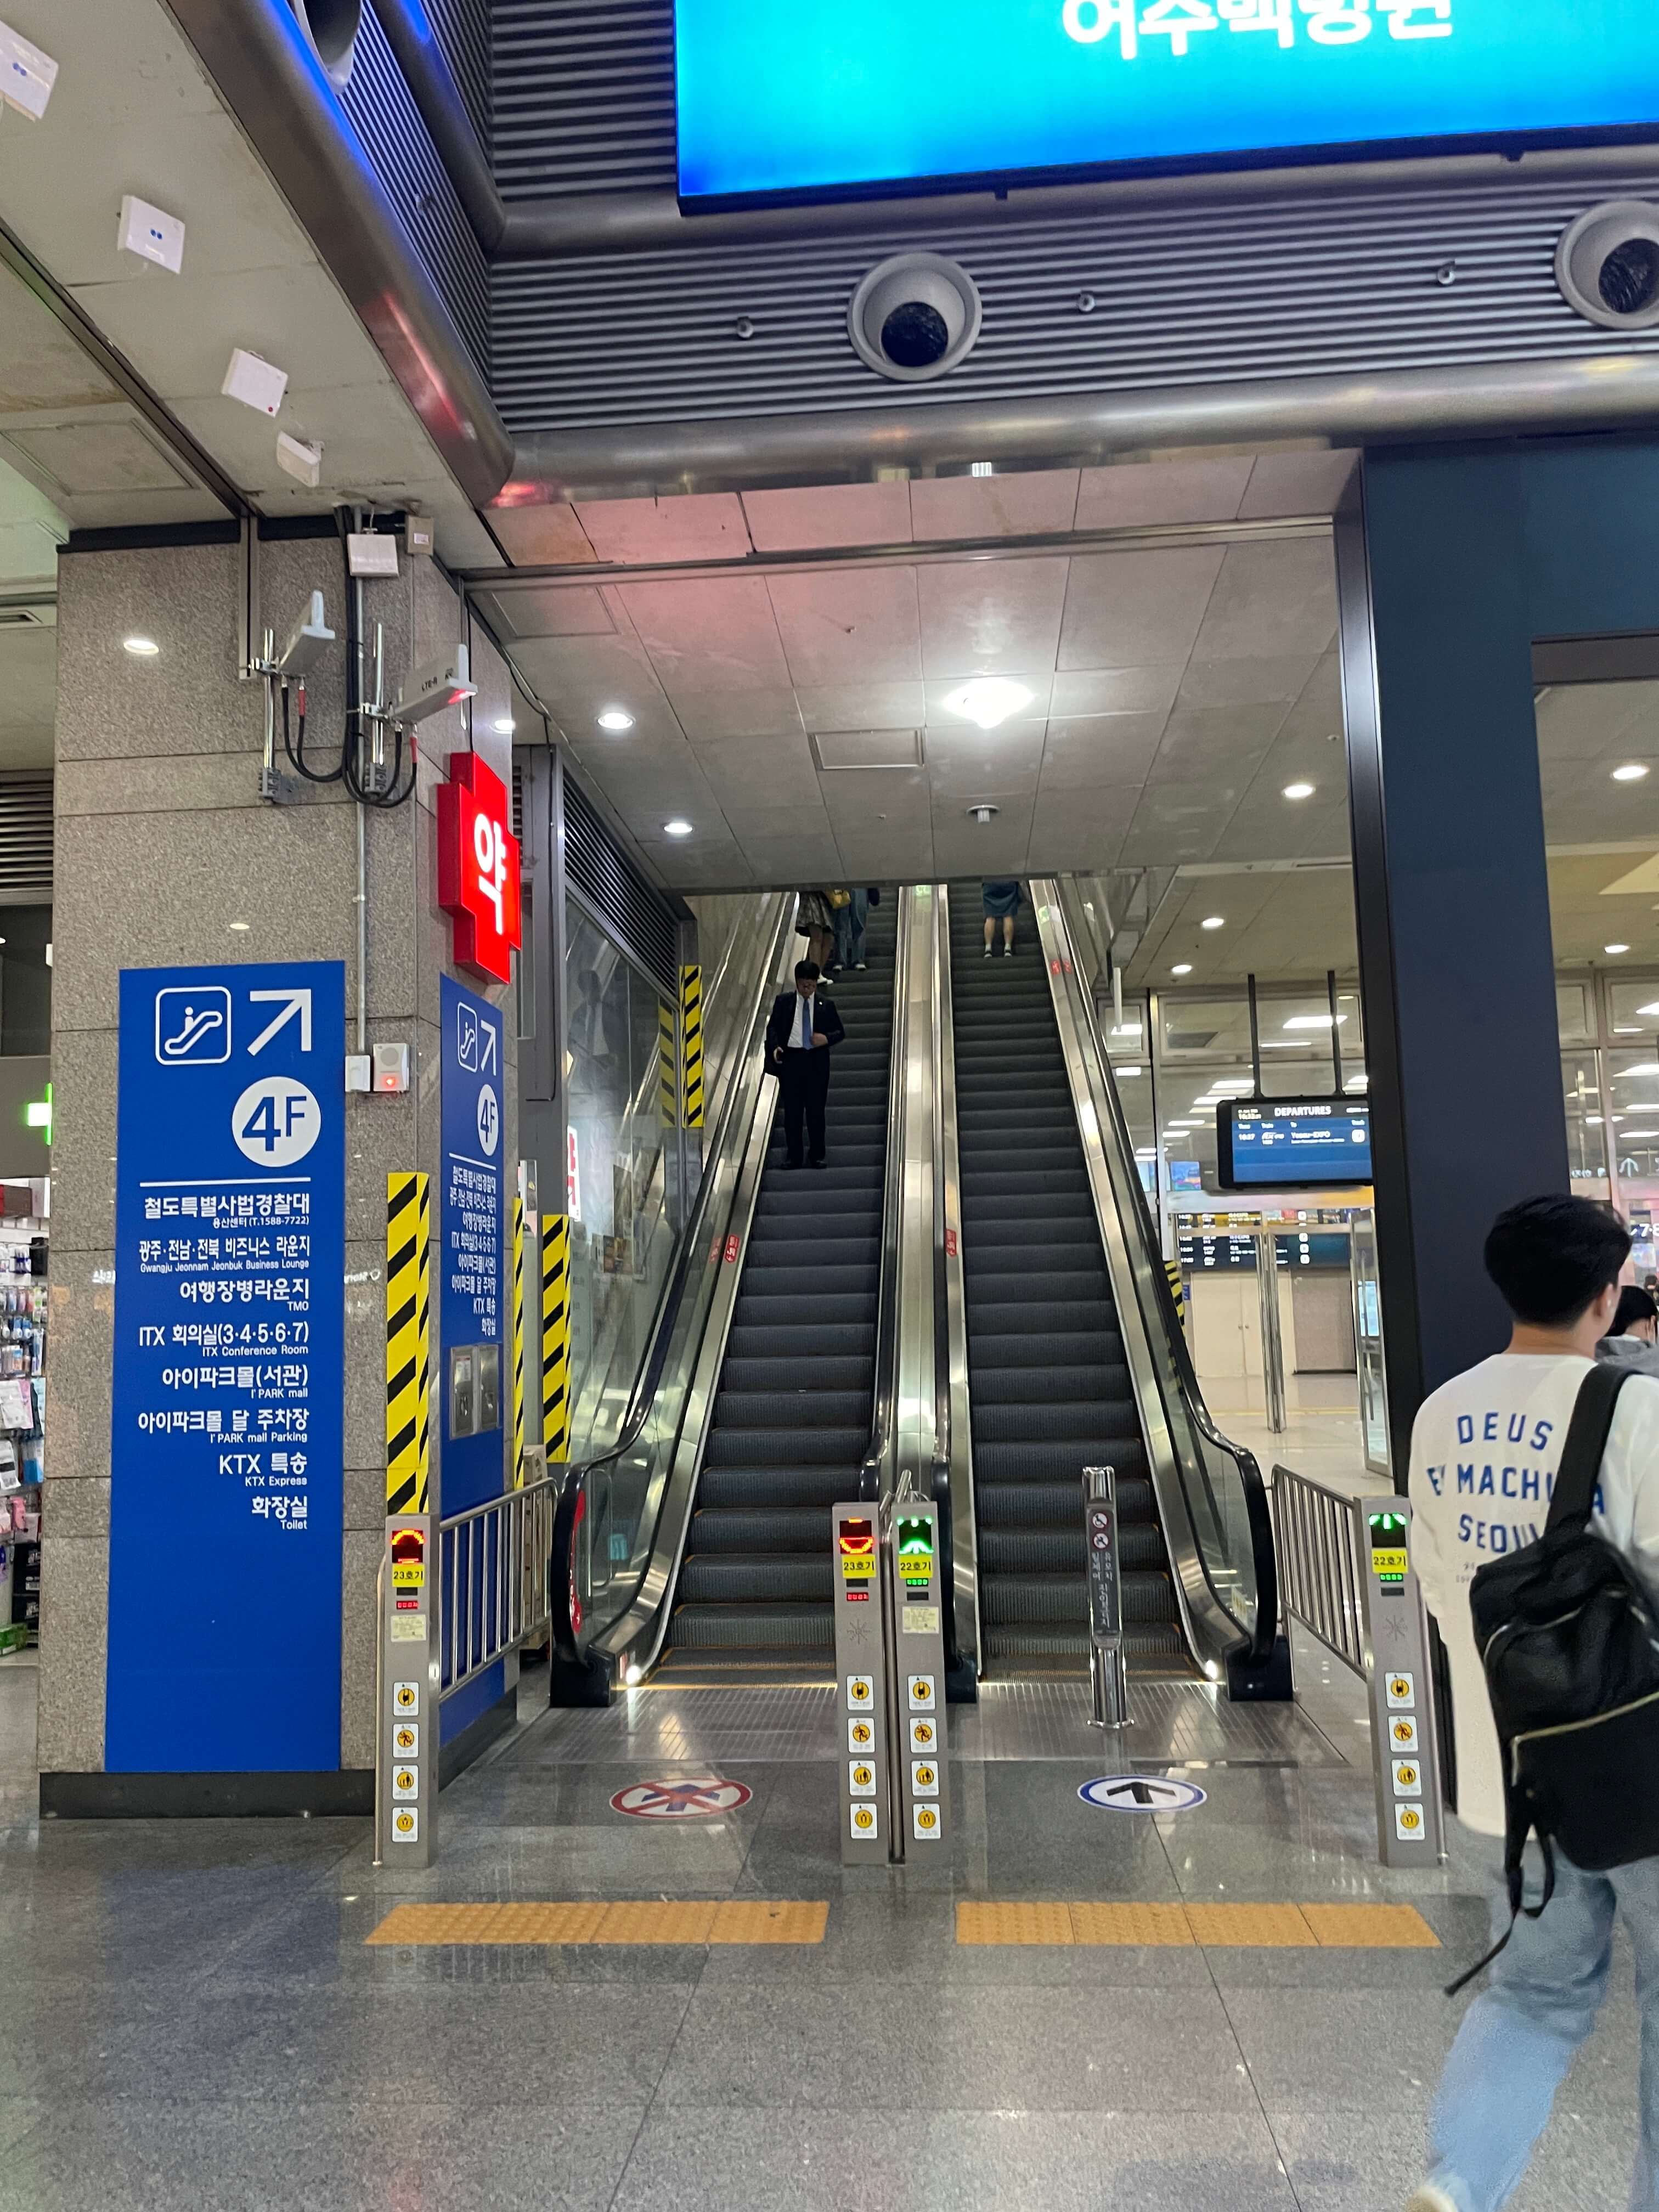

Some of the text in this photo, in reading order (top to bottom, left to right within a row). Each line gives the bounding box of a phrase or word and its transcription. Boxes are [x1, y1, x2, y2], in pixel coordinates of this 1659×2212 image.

[474, 813, 506, 935] 약
[480, 1099, 495, 1143] 4F
[1274, 1106, 1331, 1117] DEPARTURES
[242, 1096, 307, 1152] 4F
[453, 1165, 496, 1194] 철도특별사법경찰대
[144, 1193, 310, 1219] 철도특별사법경찰대
[213, 1216, 309, 1229] 용산센터 (T.1588-7722)
[462, 1211, 496, 1234] 여행장병라운지
[139, 1235, 310, 1262] 광주·전남·전북 비즈니스 라운지
[452, 1231, 460, 1249] ITX
[140, 1259, 309, 1274] Gwangju Jeonnam Jeonbuk Business Lounge
[459, 1254, 496, 1274] 아이파크몰(서관)
[179, 1278, 310, 1304] 여행장병라운지
[452, 1274, 475, 1294] 아이파크몰
[483, 1277, 496, 1295] 주차장
[288, 1301, 309, 1311] TMO
[473, 1297, 496, 1316] KTX 특송
[139, 1321, 309, 1346] ITX 회의실(3·4·5·6·7)
[482, 1318, 496, 1336] 화장실
[202, 1344, 309, 1357] ITX Conference Room
[162, 1364, 309, 1390] 아이파크몰(서관)
[288, 1387, 308, 1398] mall
[138, 1408, 310, 1434] 아이파크몰 달 주차장
[247, 1432, 268, 1443] mall
[271, 1431, 308, 1443] Parking
[1457, 1412, 1554, 1451] DEUS
[219, 1451, 308, 1475] KTX 특송
[245, 1475, 308, 1487] KTX Express
[1456, 1463, 1605, 1514] MACHIA
[252, 1495, 308, 1519] 화장실
[280, 1519, 308, 1530] Toilet
[1457, 1513, 1542, 1554] SEOU
[843, 1562, 875, 1571] 23호기
[900, 1562, 932, 1571] 22호기
[1373, 1555, 1406, 1567] 22호기
[393, 1571, 423, 1581] 23호기
